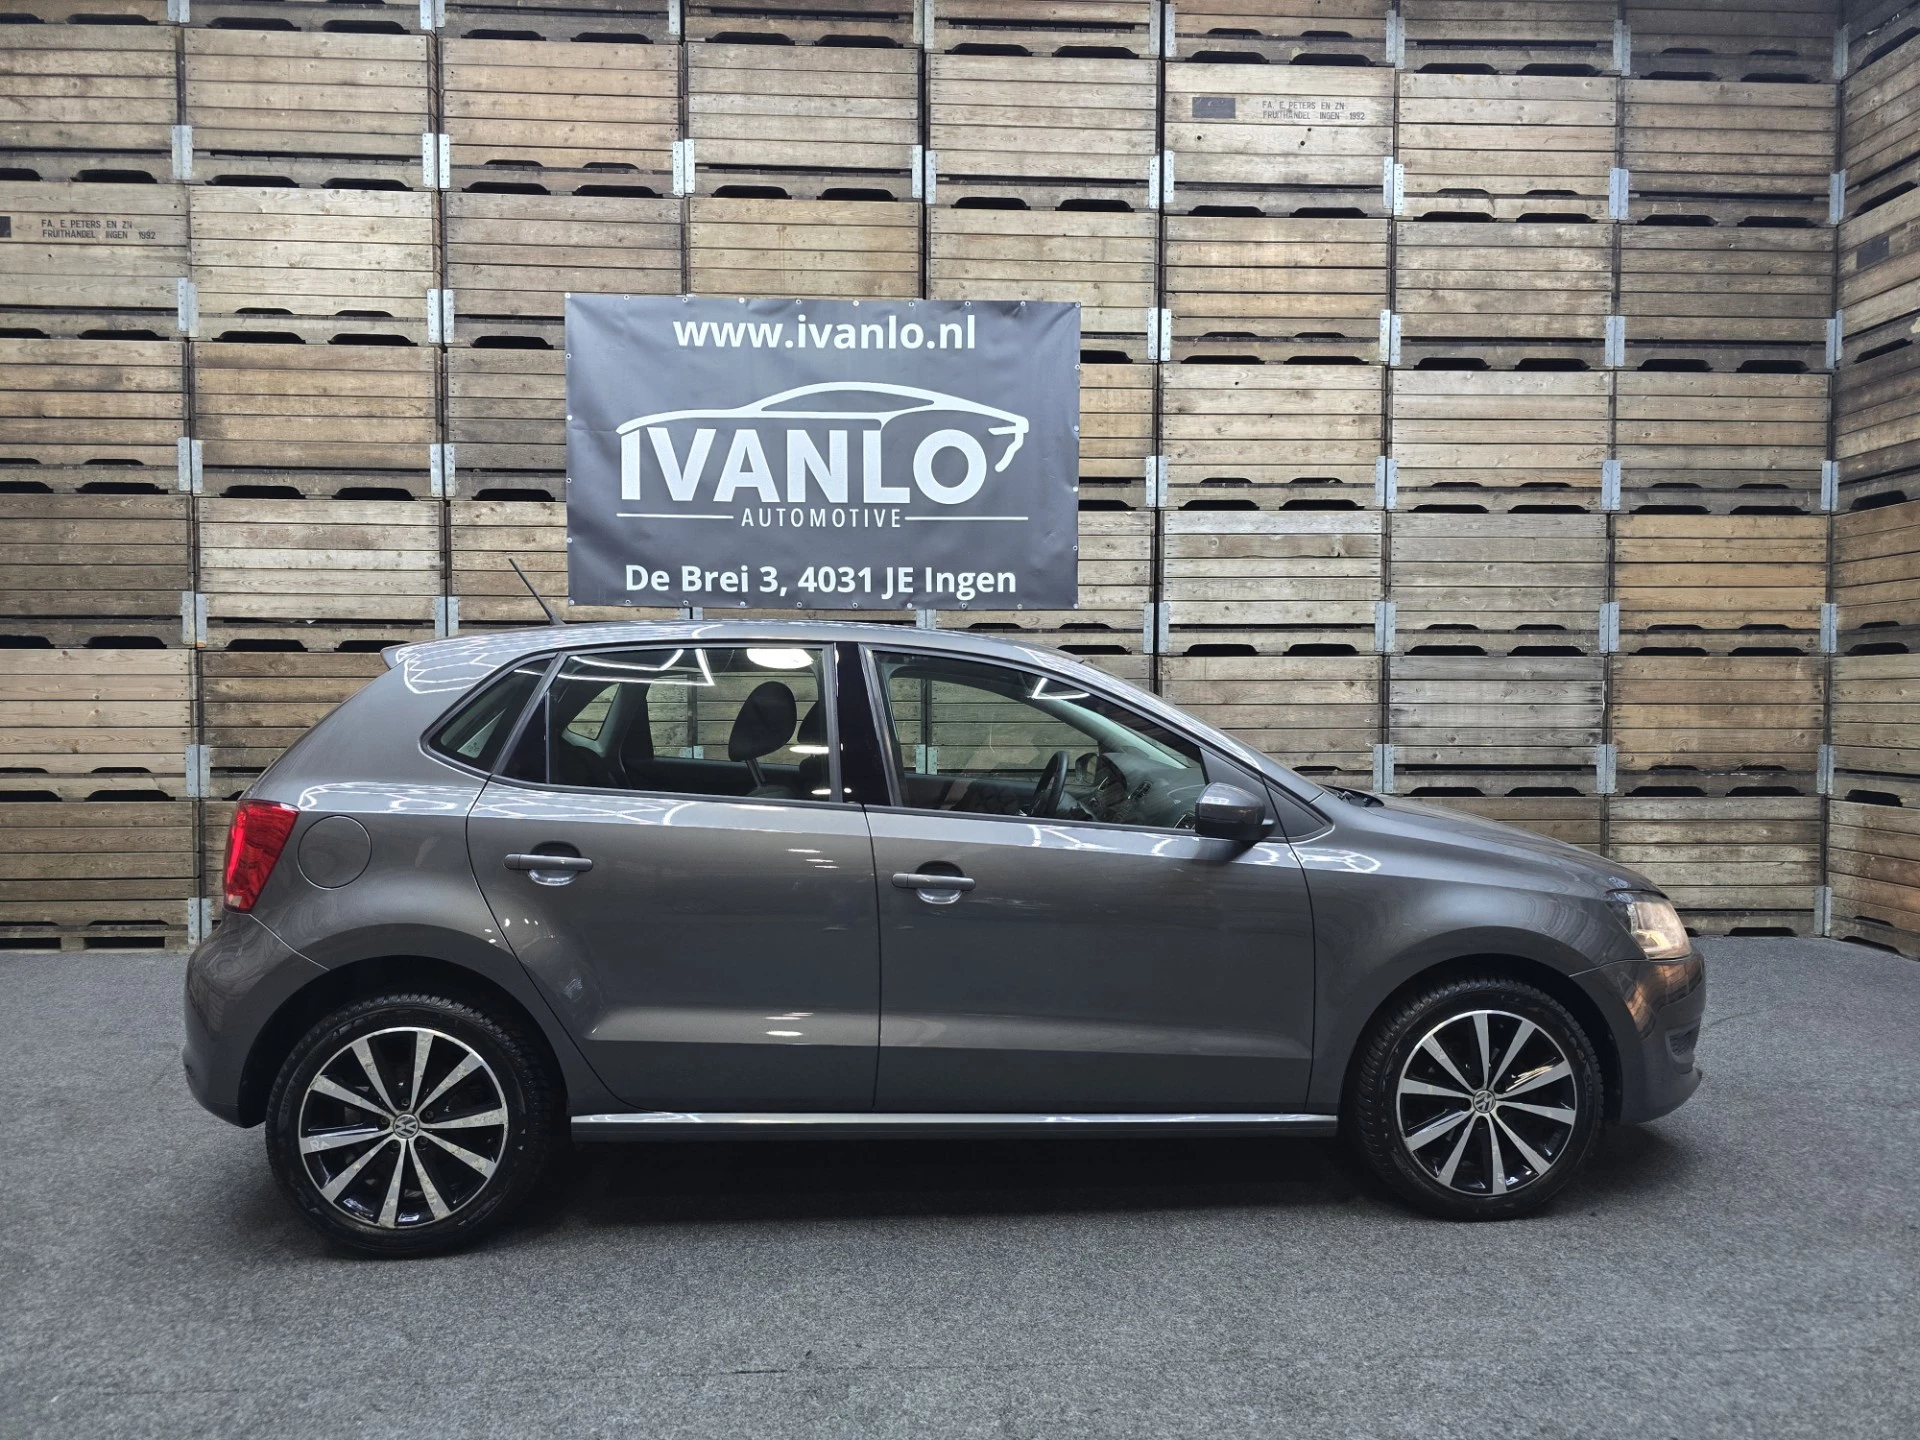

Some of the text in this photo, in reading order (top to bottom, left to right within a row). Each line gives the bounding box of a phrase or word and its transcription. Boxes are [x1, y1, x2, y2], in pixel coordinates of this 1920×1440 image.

[1288, 101, 1316, 109] PETERS
[1320, 102, 1330, 110] EN
[1319, 112, 1340, 120] INGEN
[70, 219, 101, 228] PETERS
[106, 220, 117, 229] EN
[42, 229, 156, 240] FRUITHANDEL INGEN 1992
[672, 314, 976, 350] www.ivanlo.nl
[620, 426, 987, 505] IVANLO
[741, 507, 902, 528] AUTOMOTIVE
[625, 564, 1017, 601] De Brei 3, 4031 JE Ingen
